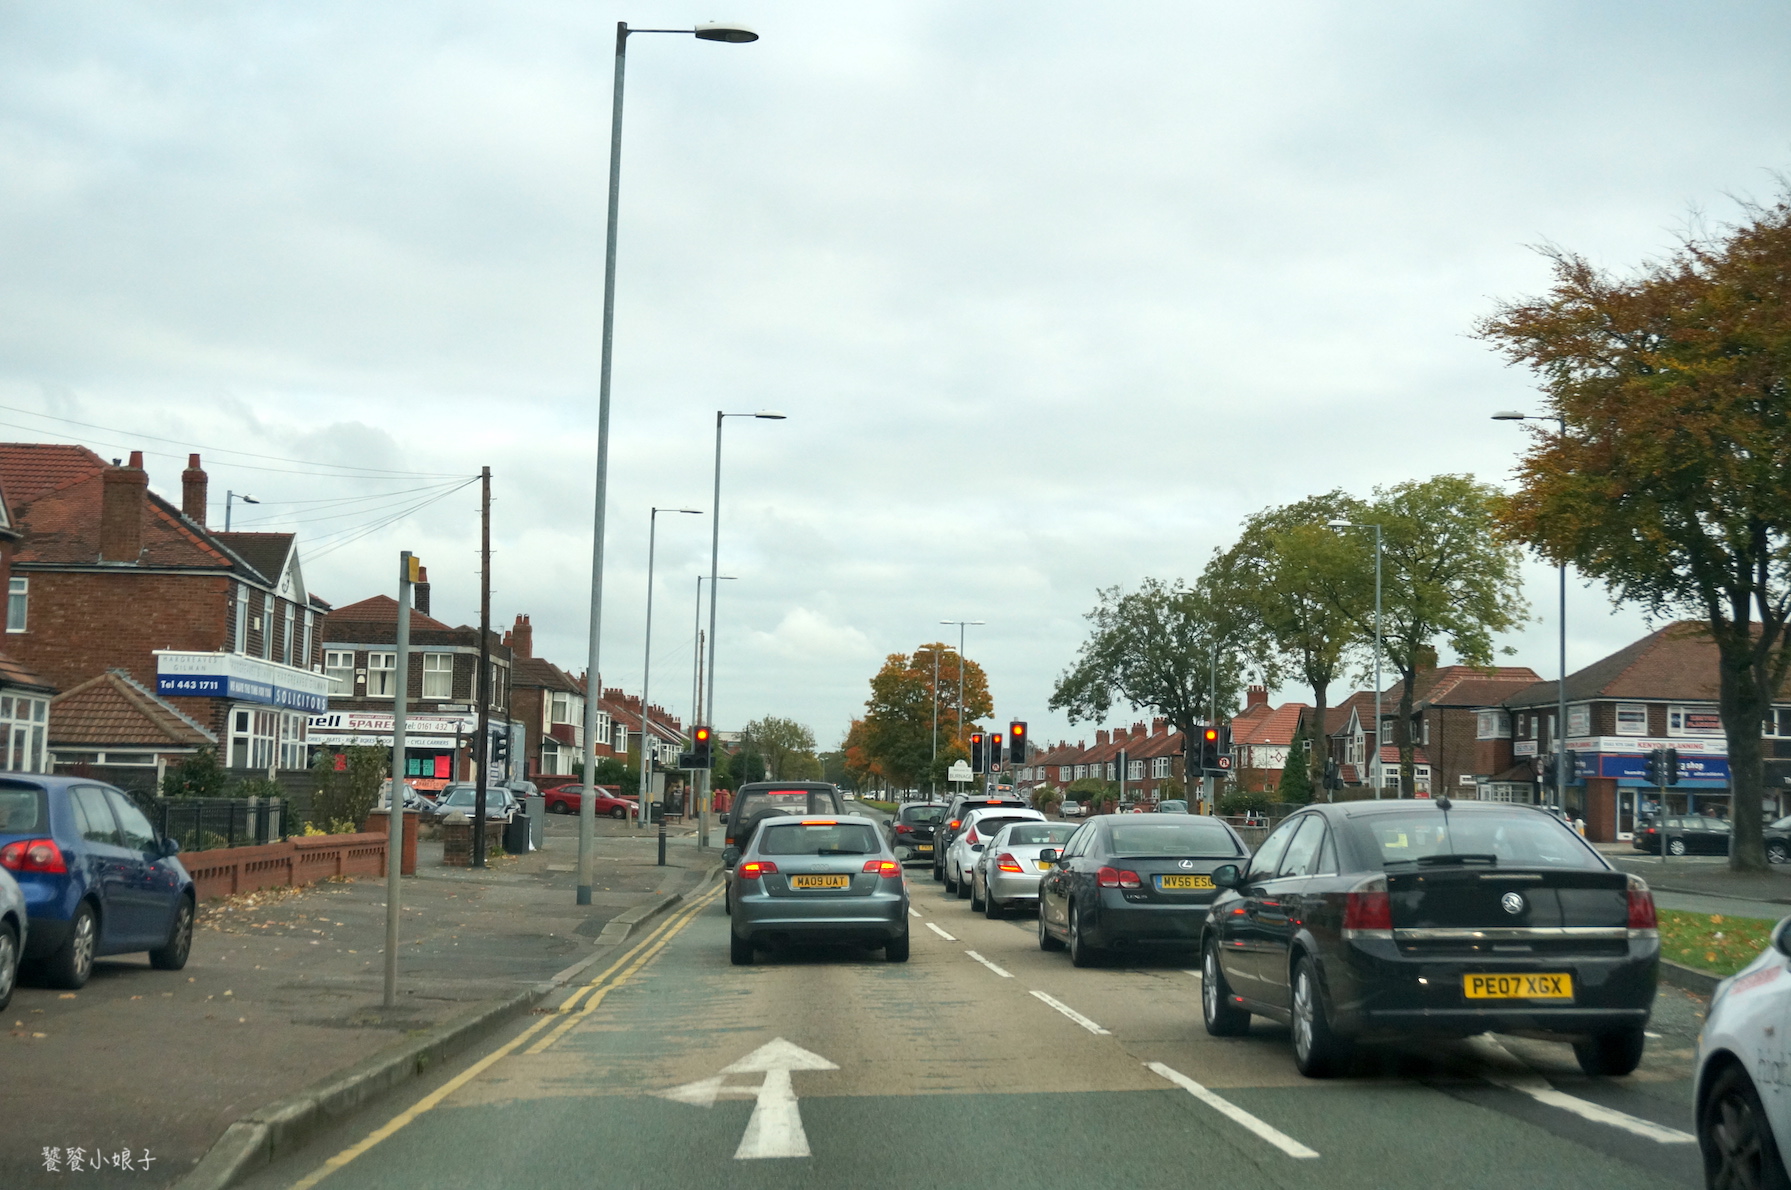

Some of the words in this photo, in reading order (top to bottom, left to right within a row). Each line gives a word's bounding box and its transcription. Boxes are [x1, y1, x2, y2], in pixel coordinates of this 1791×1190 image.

[160, 680, 175, 689] Tel
[177, 680, 197, 689] 443
[199, 681, 218, 690] 1711
[276, 689, 326, 711] SOLICITORS
[417, 722, 432, 730] 0161
[435, 723, 448, 731] 432
[451, 723, 466, 731] 170
[1668, 742, 1704, 750] PLANNING
[1686, 761, 1704, 771] shop
[797, 877, 823, 886] MA09
[826, 876, 845, 886] UAT
[1164, 877, 1191, 887] MV56
[1473, 977, 1521, 994] PE07
[1526, 977, 1562, 994] XGX
